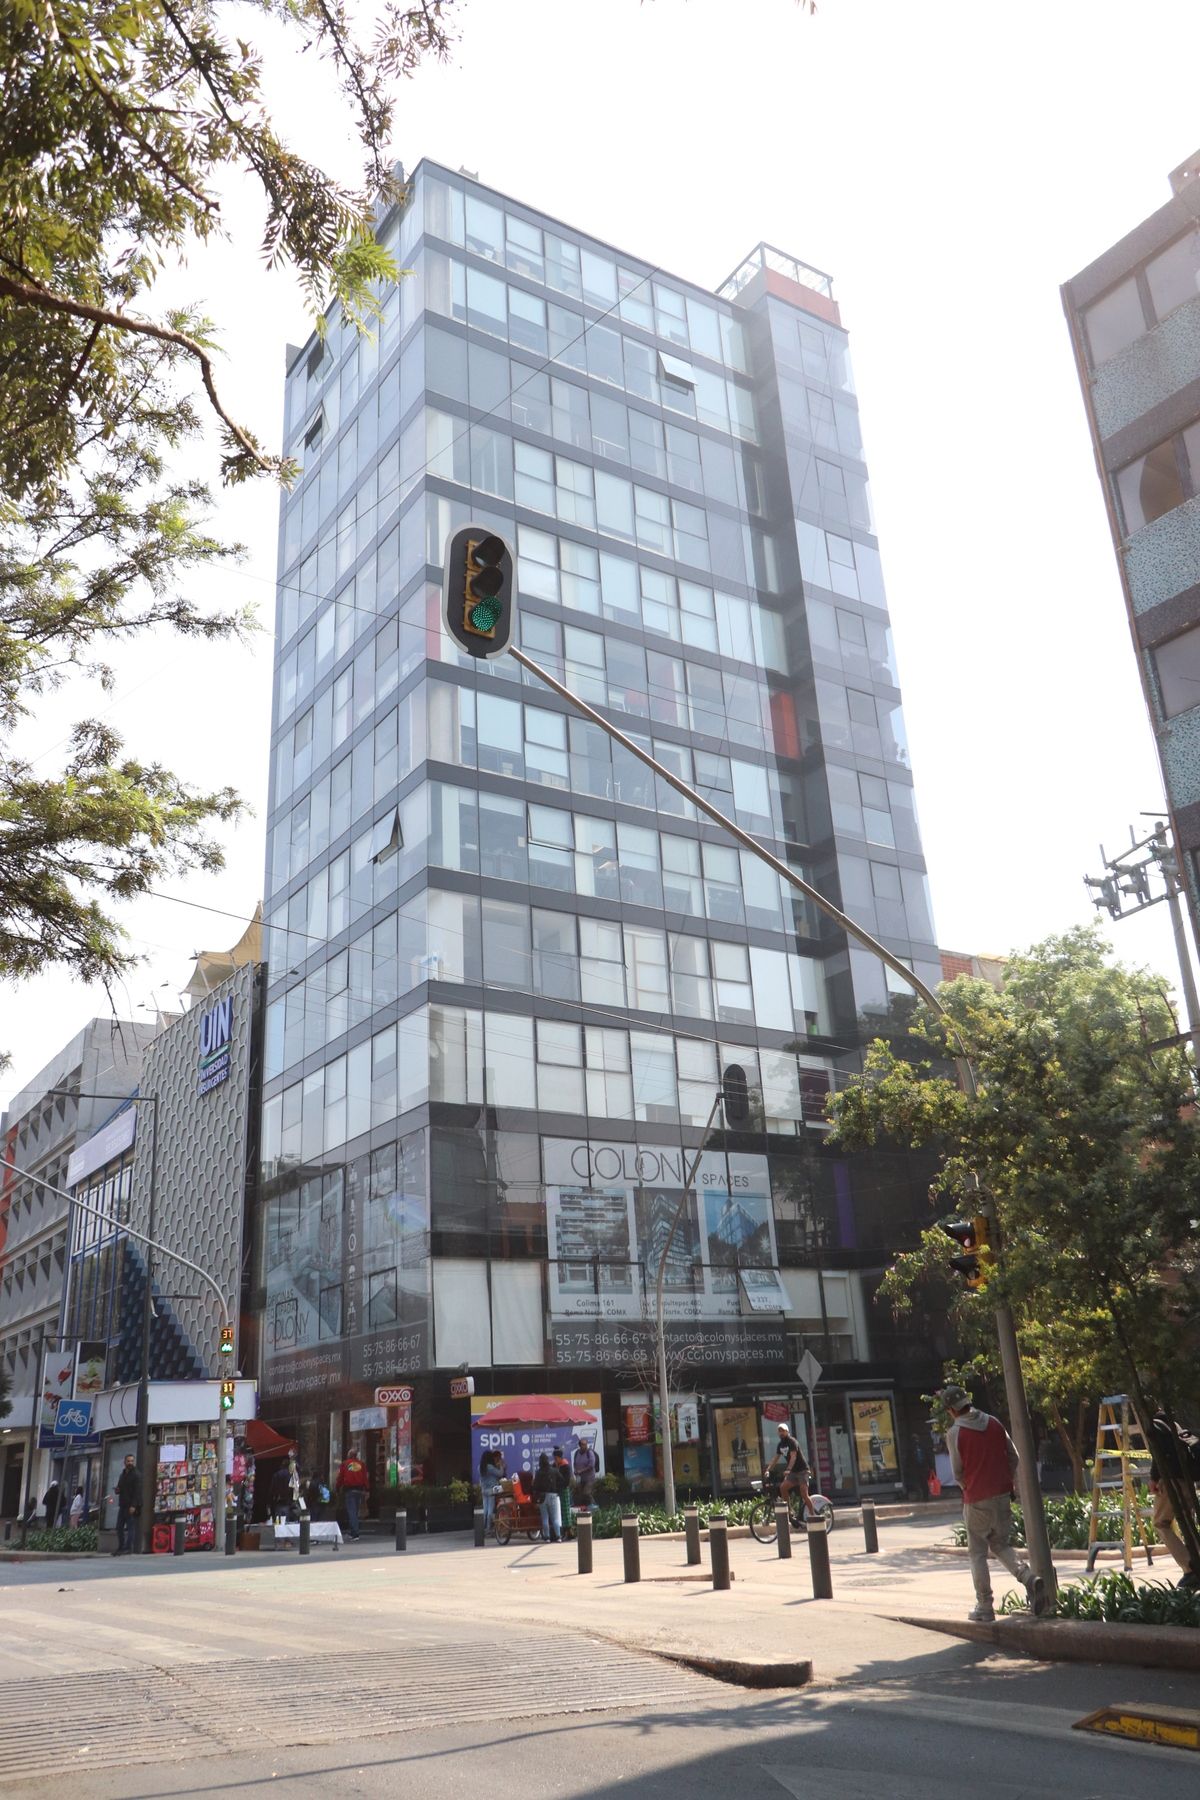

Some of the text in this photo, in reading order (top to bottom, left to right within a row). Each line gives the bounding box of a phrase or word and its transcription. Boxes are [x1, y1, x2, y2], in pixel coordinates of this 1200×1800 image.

[200, 995, 233, 1057] UIN
[571, 1145, 702, 1183] COLONY
[363, 1334, 420, 1358] 55-75-86-66-67
[380, 1389, 411, 1404] OXXO
[480, 1432, 515, 1450] spin
